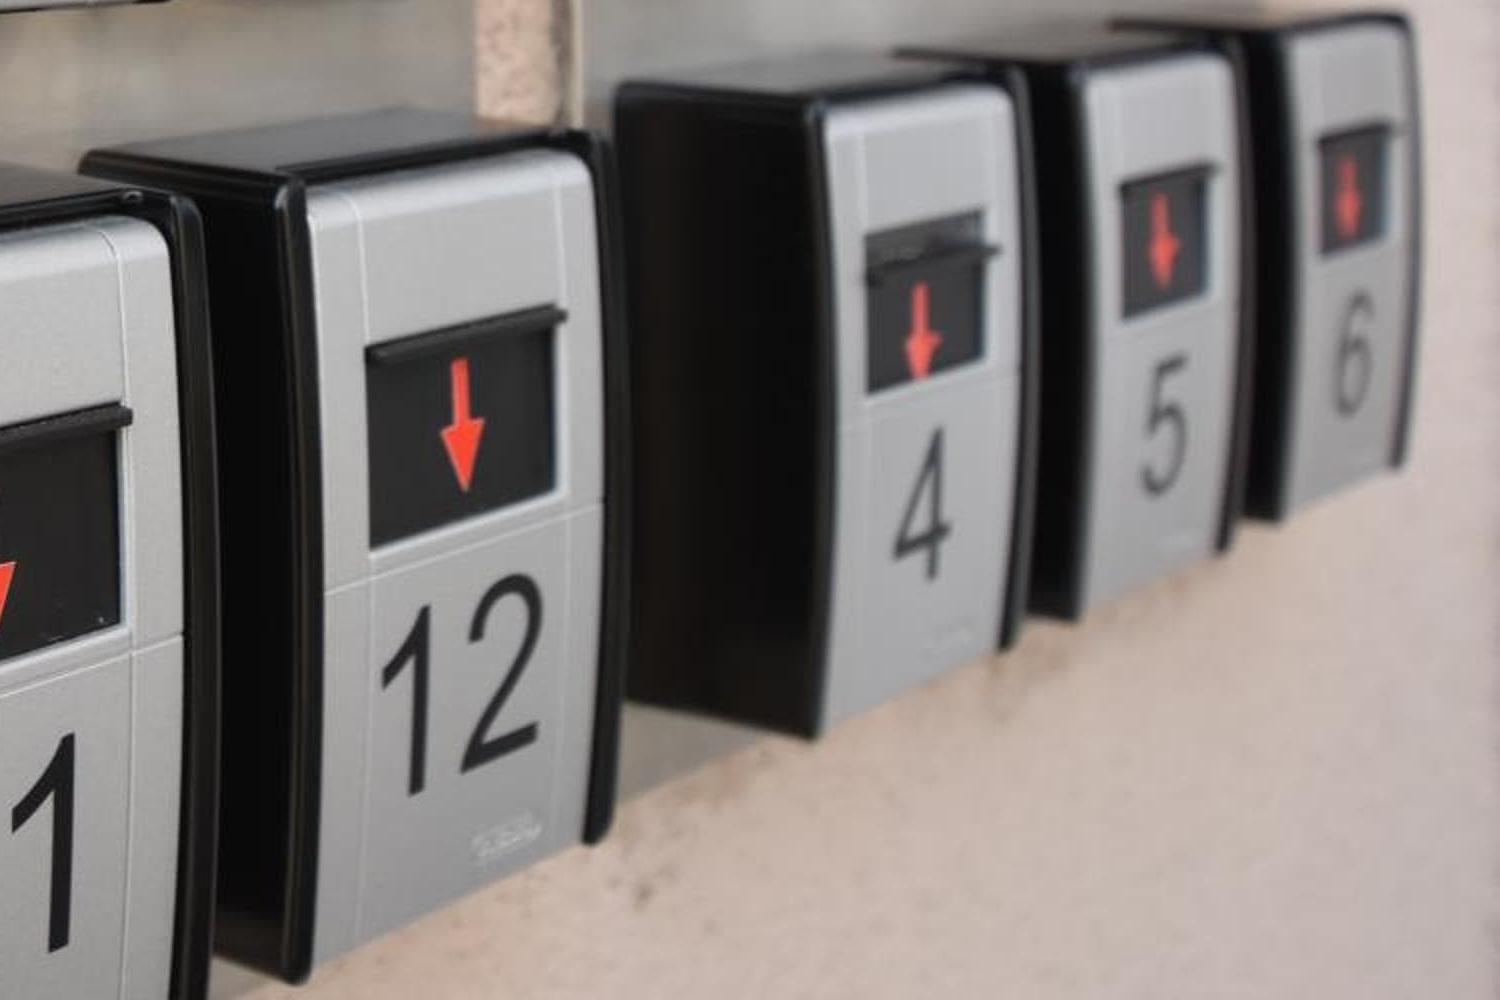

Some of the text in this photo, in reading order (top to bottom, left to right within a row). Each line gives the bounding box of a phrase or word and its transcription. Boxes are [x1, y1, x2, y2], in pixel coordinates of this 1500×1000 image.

[1138, 352, 1190, 501] 5
[1331, 288, 1376, 422] 6
[891, 426, 953, 582] 4
[381, 573, 543, 796] 12
